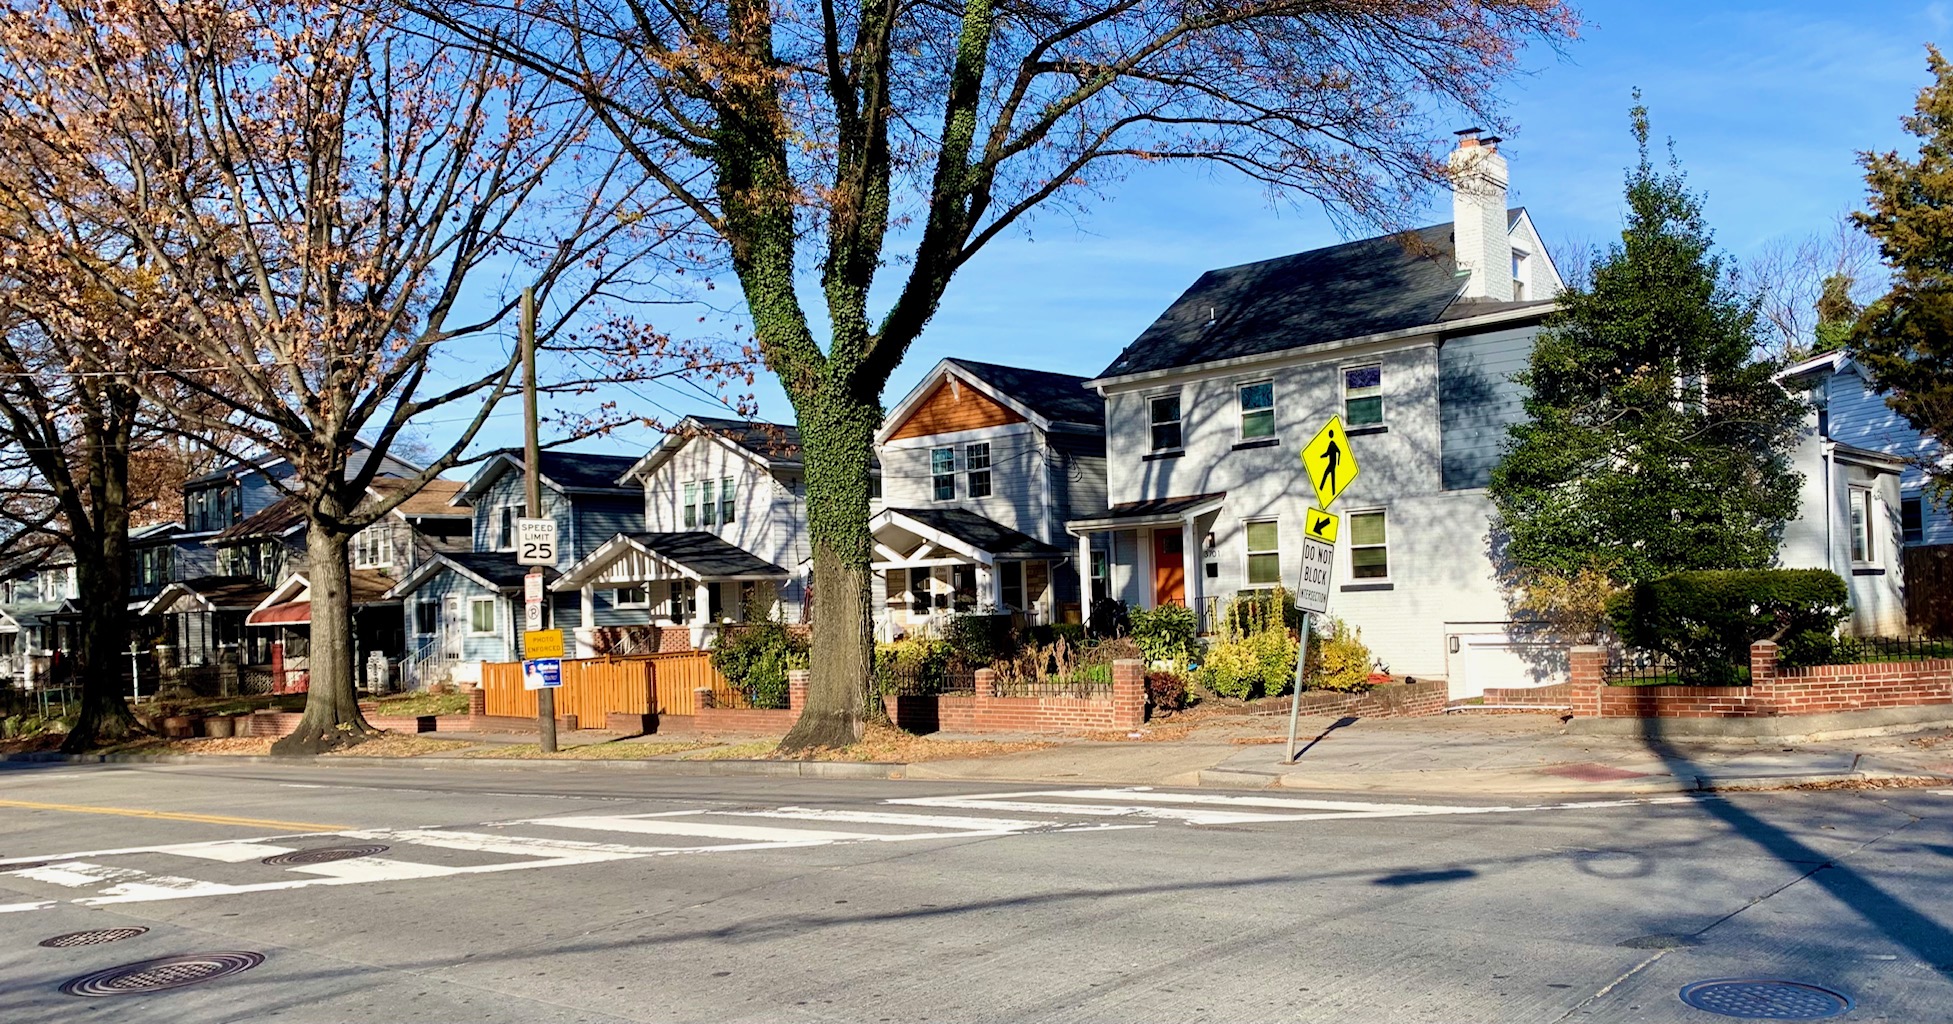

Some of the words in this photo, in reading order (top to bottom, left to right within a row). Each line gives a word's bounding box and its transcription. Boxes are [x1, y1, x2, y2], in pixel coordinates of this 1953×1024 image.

[521, 523, 554, 532] SPEED
[525, 533, 550, 541] LIMIT
[523, 543, 552, 559] 25
[1203, 550, 1221, 558] 3701
[1304, 544, 1315, 561] DO
[1317, 545, 1332, 565] NOT
[1304, 566, 1327, 586] BLOCK
[1300, 588, 1327, 604] INTERSECTION
[527, 645, 561, 653] ENFORCED
